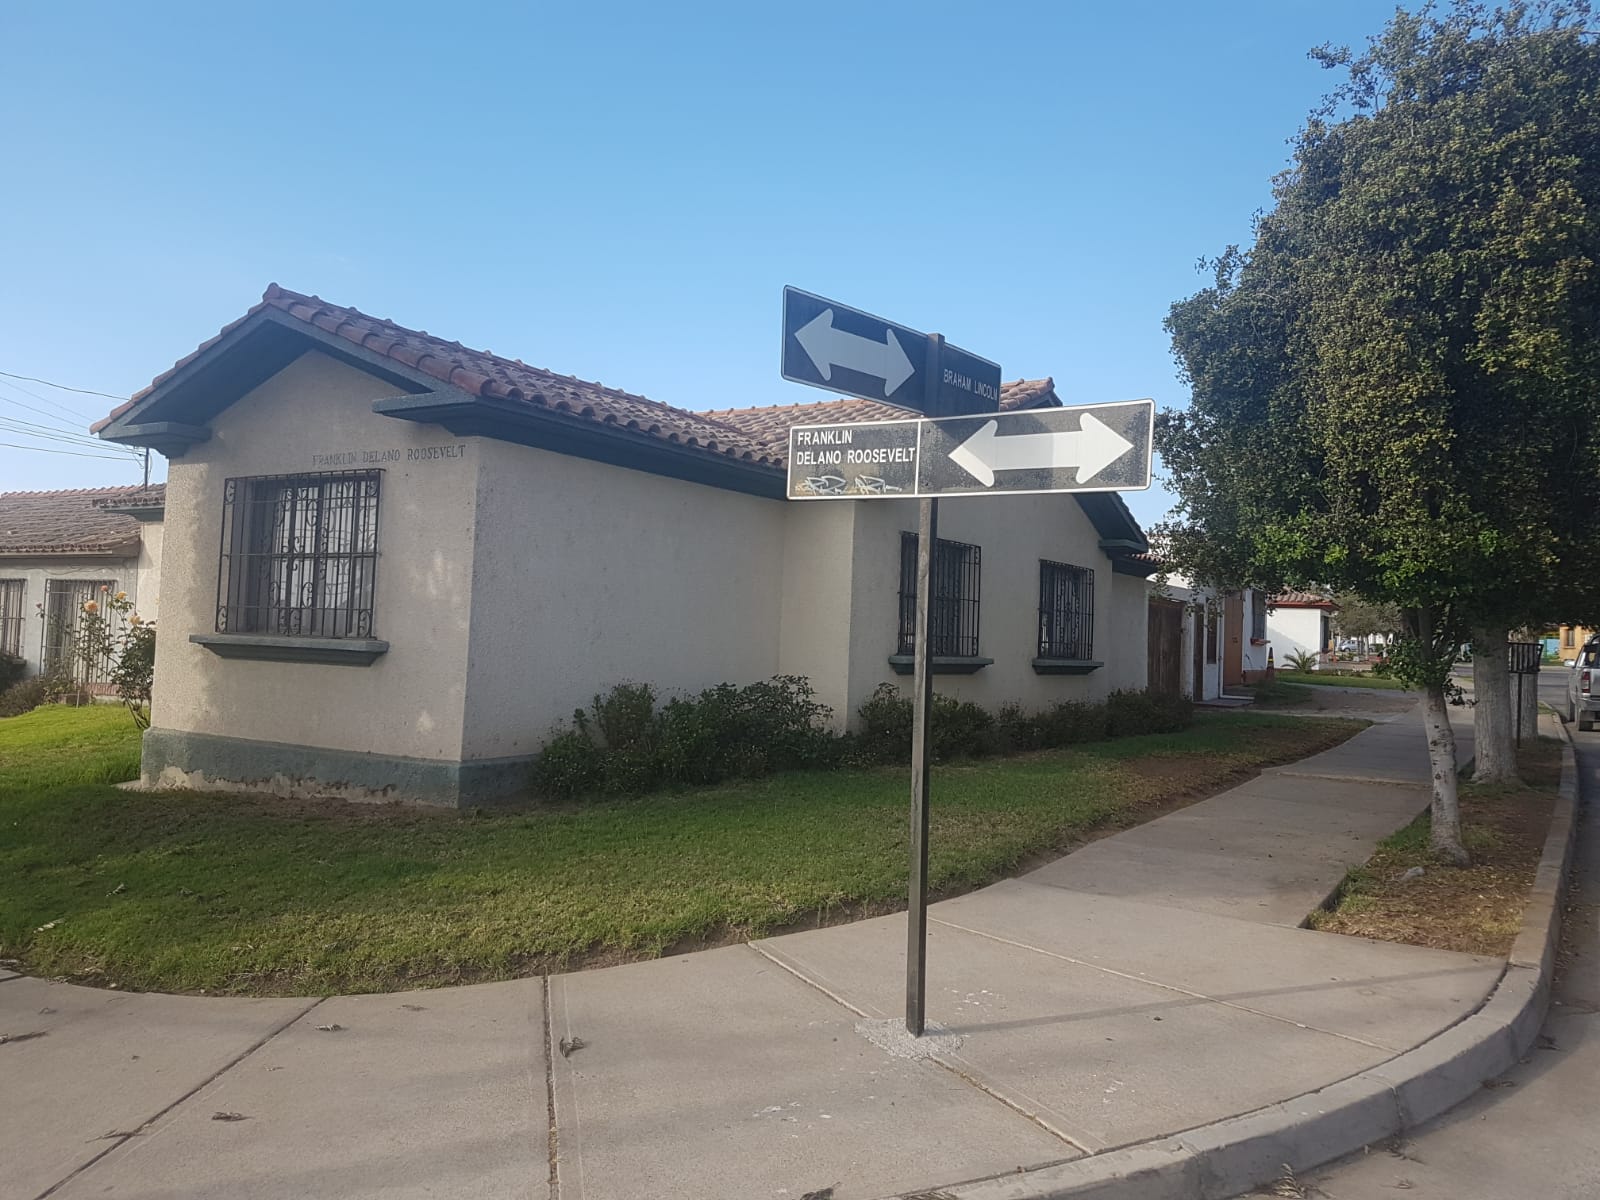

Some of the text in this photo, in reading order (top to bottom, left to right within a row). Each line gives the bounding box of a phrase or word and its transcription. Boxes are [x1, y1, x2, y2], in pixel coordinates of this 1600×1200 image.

[797, 429, 852, 446] FRANKLIN
[312, 444, 466, 466] FRANKLIN DELANO ROOSEVELT
[796, 447, 916, 465] DELANO ROOSEVELT
